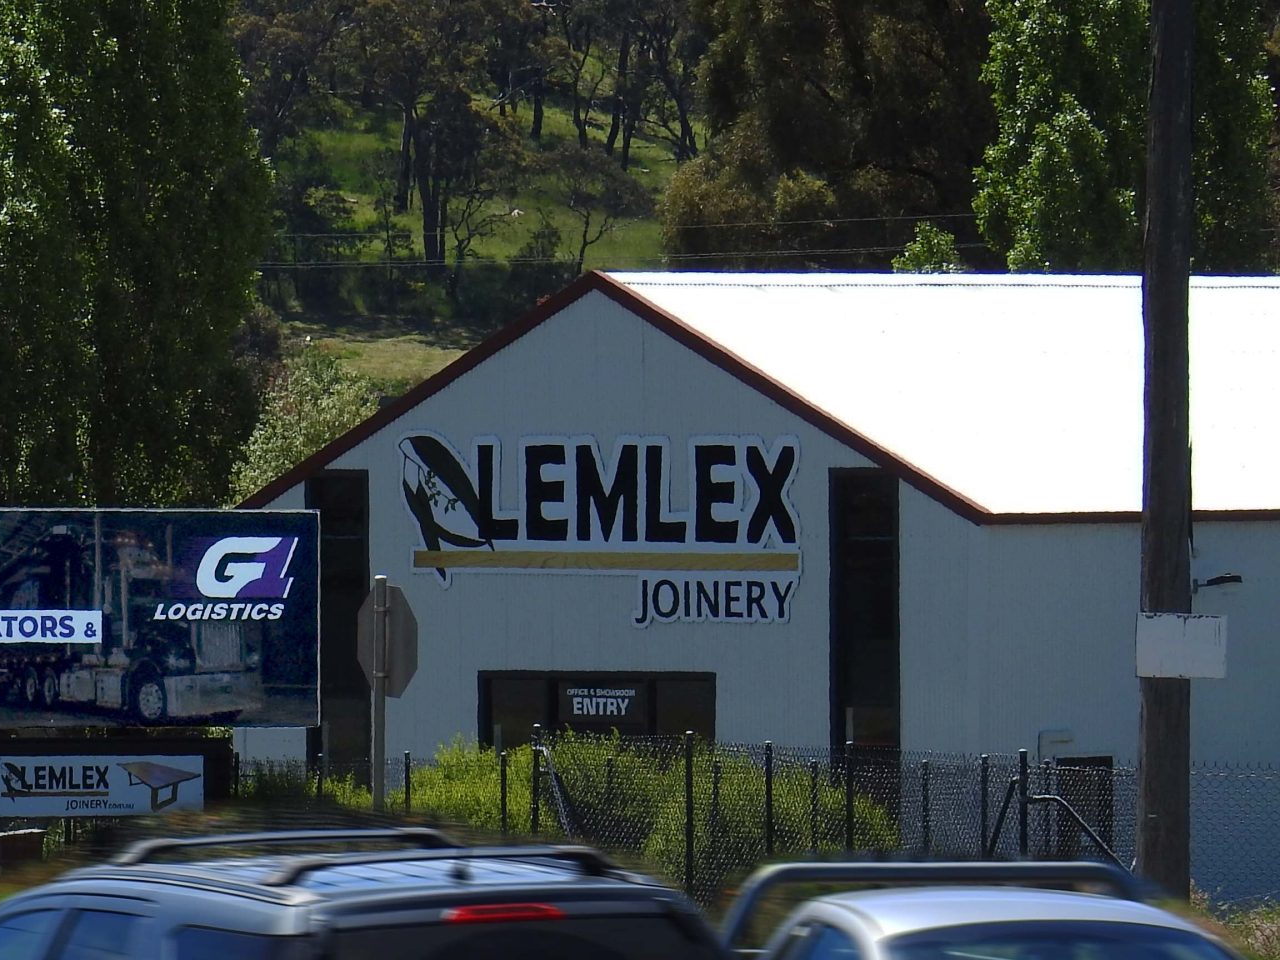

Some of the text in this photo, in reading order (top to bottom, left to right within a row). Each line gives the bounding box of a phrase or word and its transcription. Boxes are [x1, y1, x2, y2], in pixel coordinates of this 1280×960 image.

[477, 443, 796, 544] LEMLEX
[634, 580, 793, 624] JOINERY
[153, 603, 285, 621] LOGISTICS
[84, 622, 97, 637] &
[566, 688, 589, 696] OFFICE
[573, 697, 629, 716] ENTRY
[21, 765, 109, 790] LEMLEX
